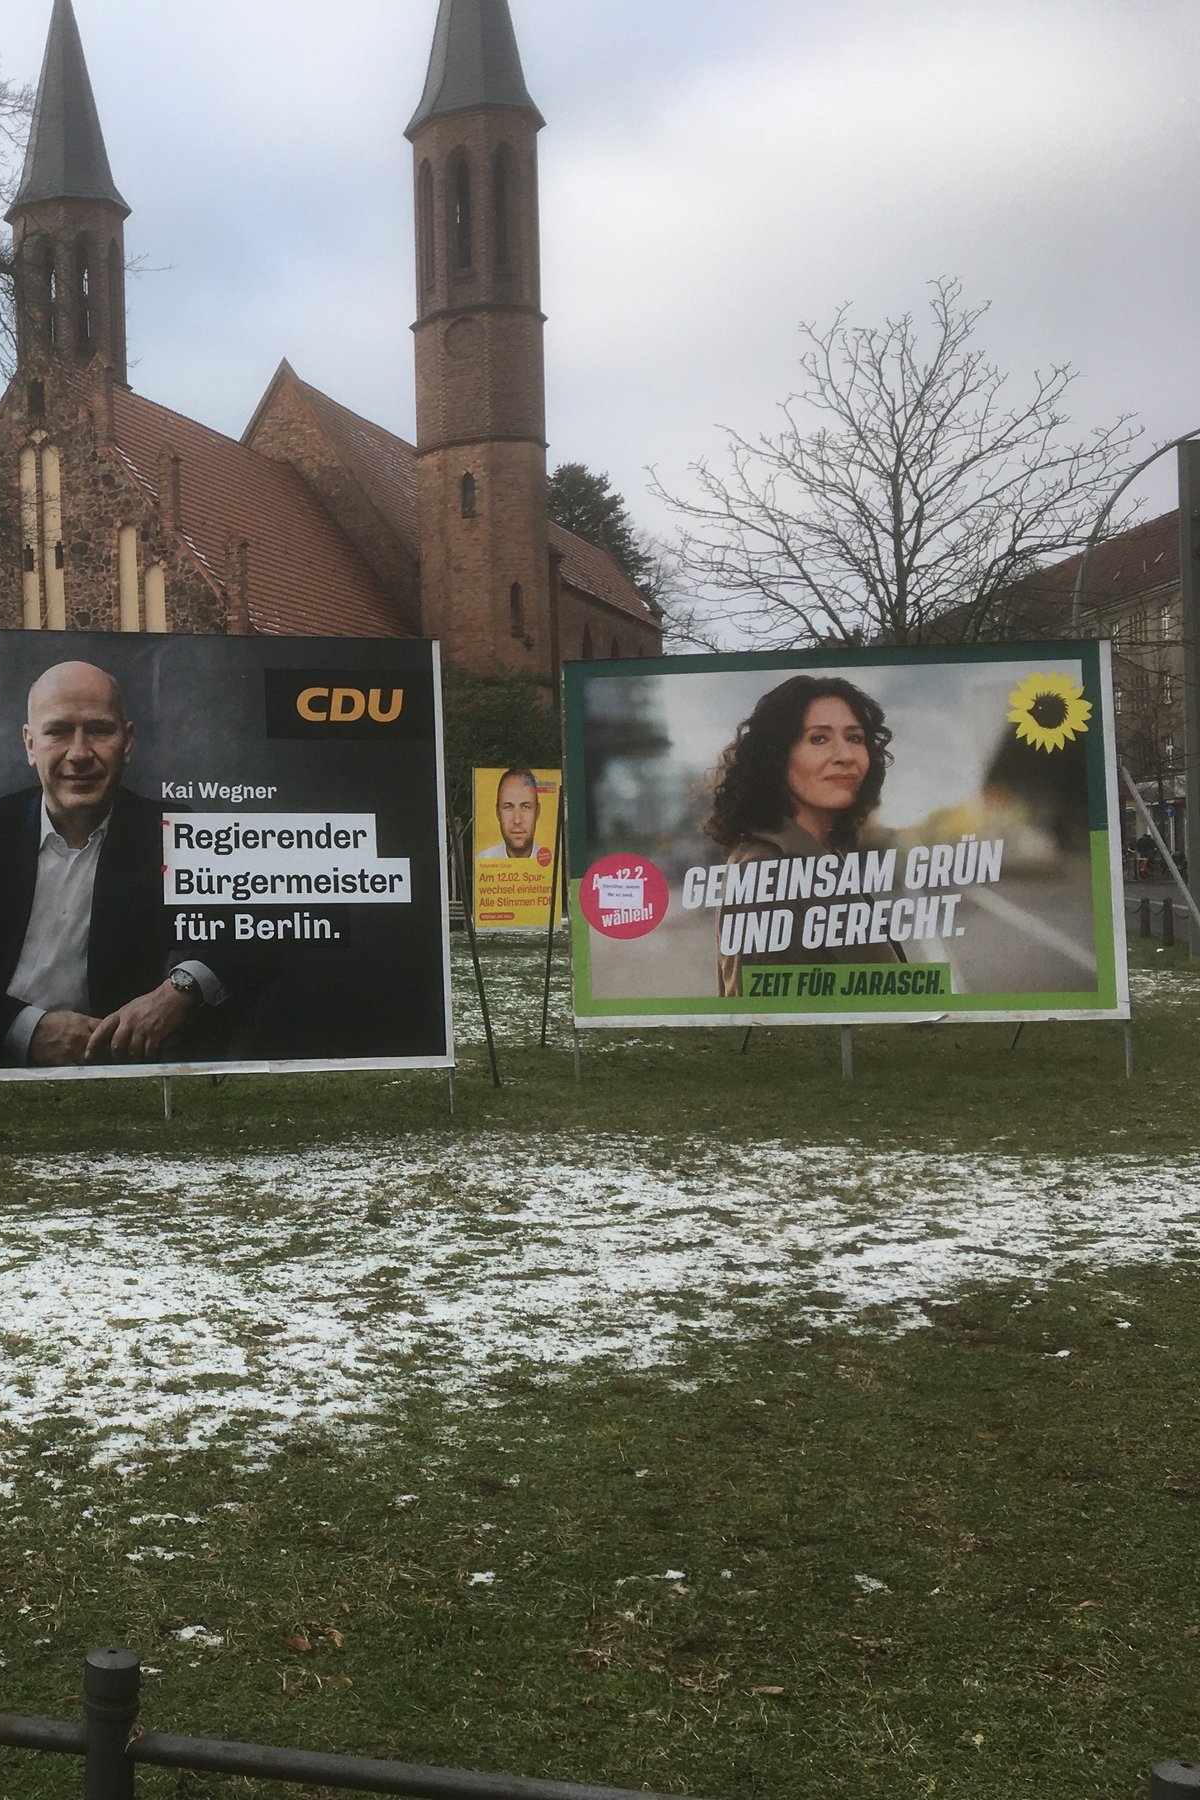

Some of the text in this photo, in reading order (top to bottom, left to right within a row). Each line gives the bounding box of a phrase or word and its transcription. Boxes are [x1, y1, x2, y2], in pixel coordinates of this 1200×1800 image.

[296, 687, 404, 723] CDU
[161, 781, 277, 803] Kai Wegner
[174, 822, 367, 855] Regierender
[174, 867, 404, 900] Bürgermeister
[682, 833, 1004, 910] GEMEINSAM GRÜN
[174, 912, 340, 941] für Berlin.
[602, 903, 653, 927] wählen!
[720, 894, 965, 956] UND GERECHT.
[749, 968, 945, 997] ZEIT FÜR JARASCH.
